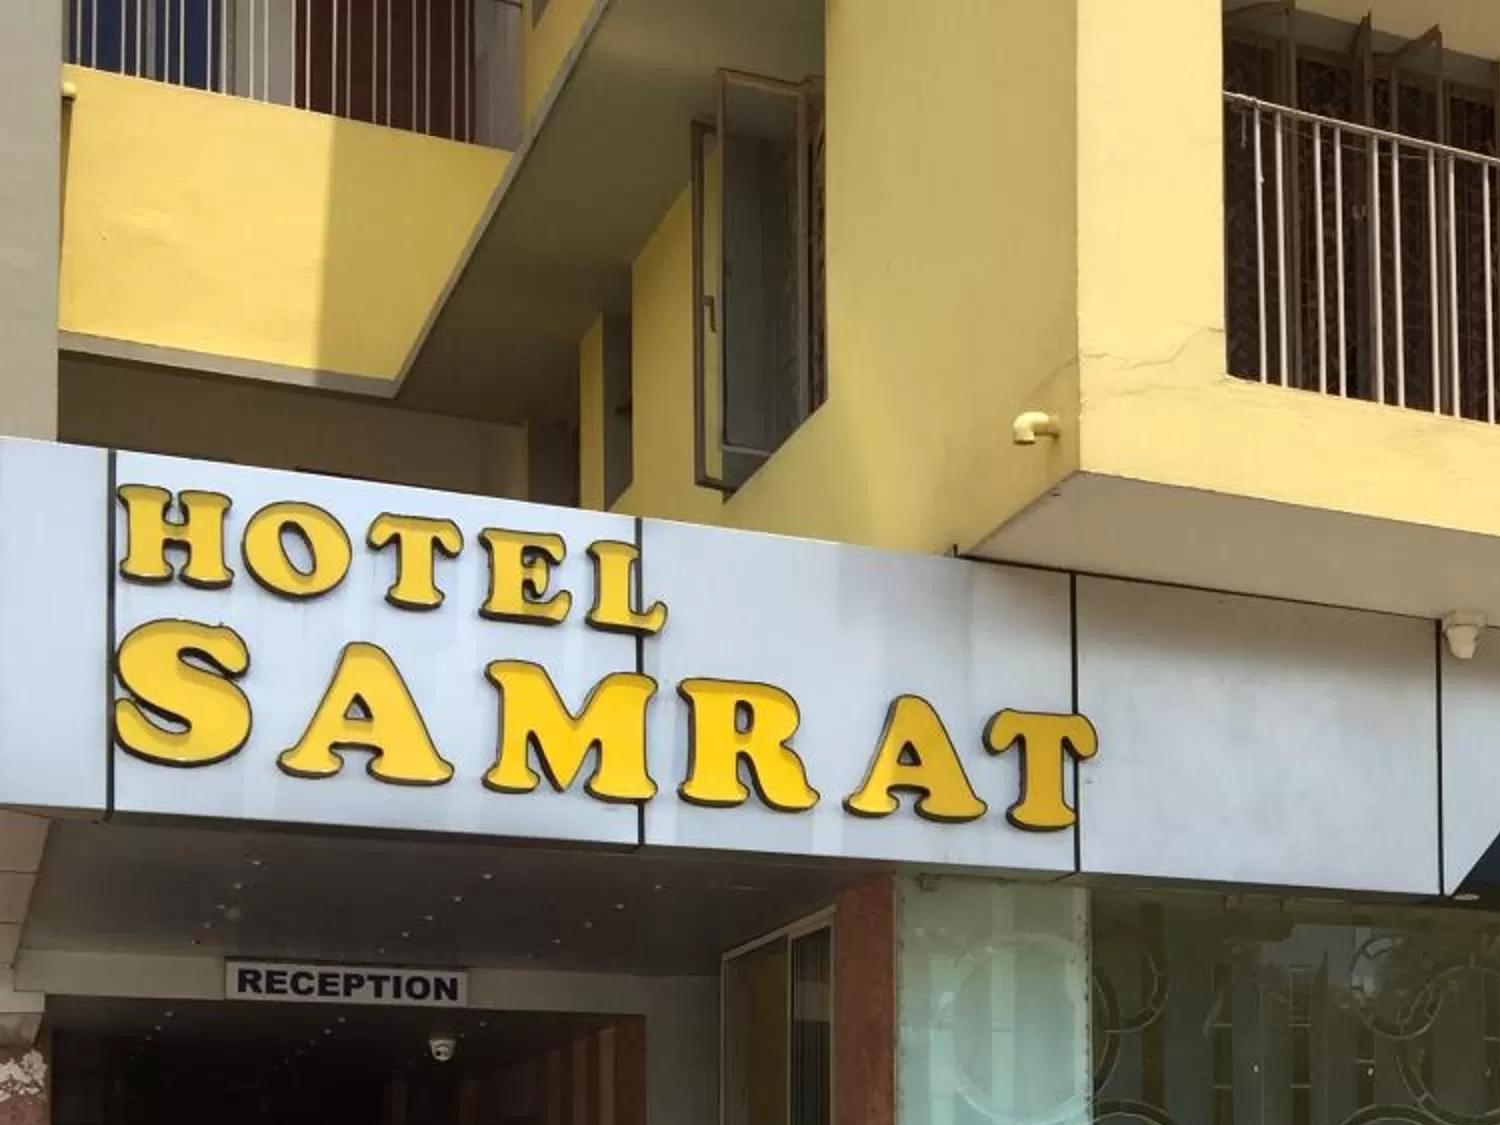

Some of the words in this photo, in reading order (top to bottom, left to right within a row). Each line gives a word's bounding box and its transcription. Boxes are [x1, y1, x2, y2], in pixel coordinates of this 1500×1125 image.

[117, 484, 668, 636] HOTEL
[113, 617, 1099, 832] SAMRAT
[237, 968, 459, 1001] RECEPTION
